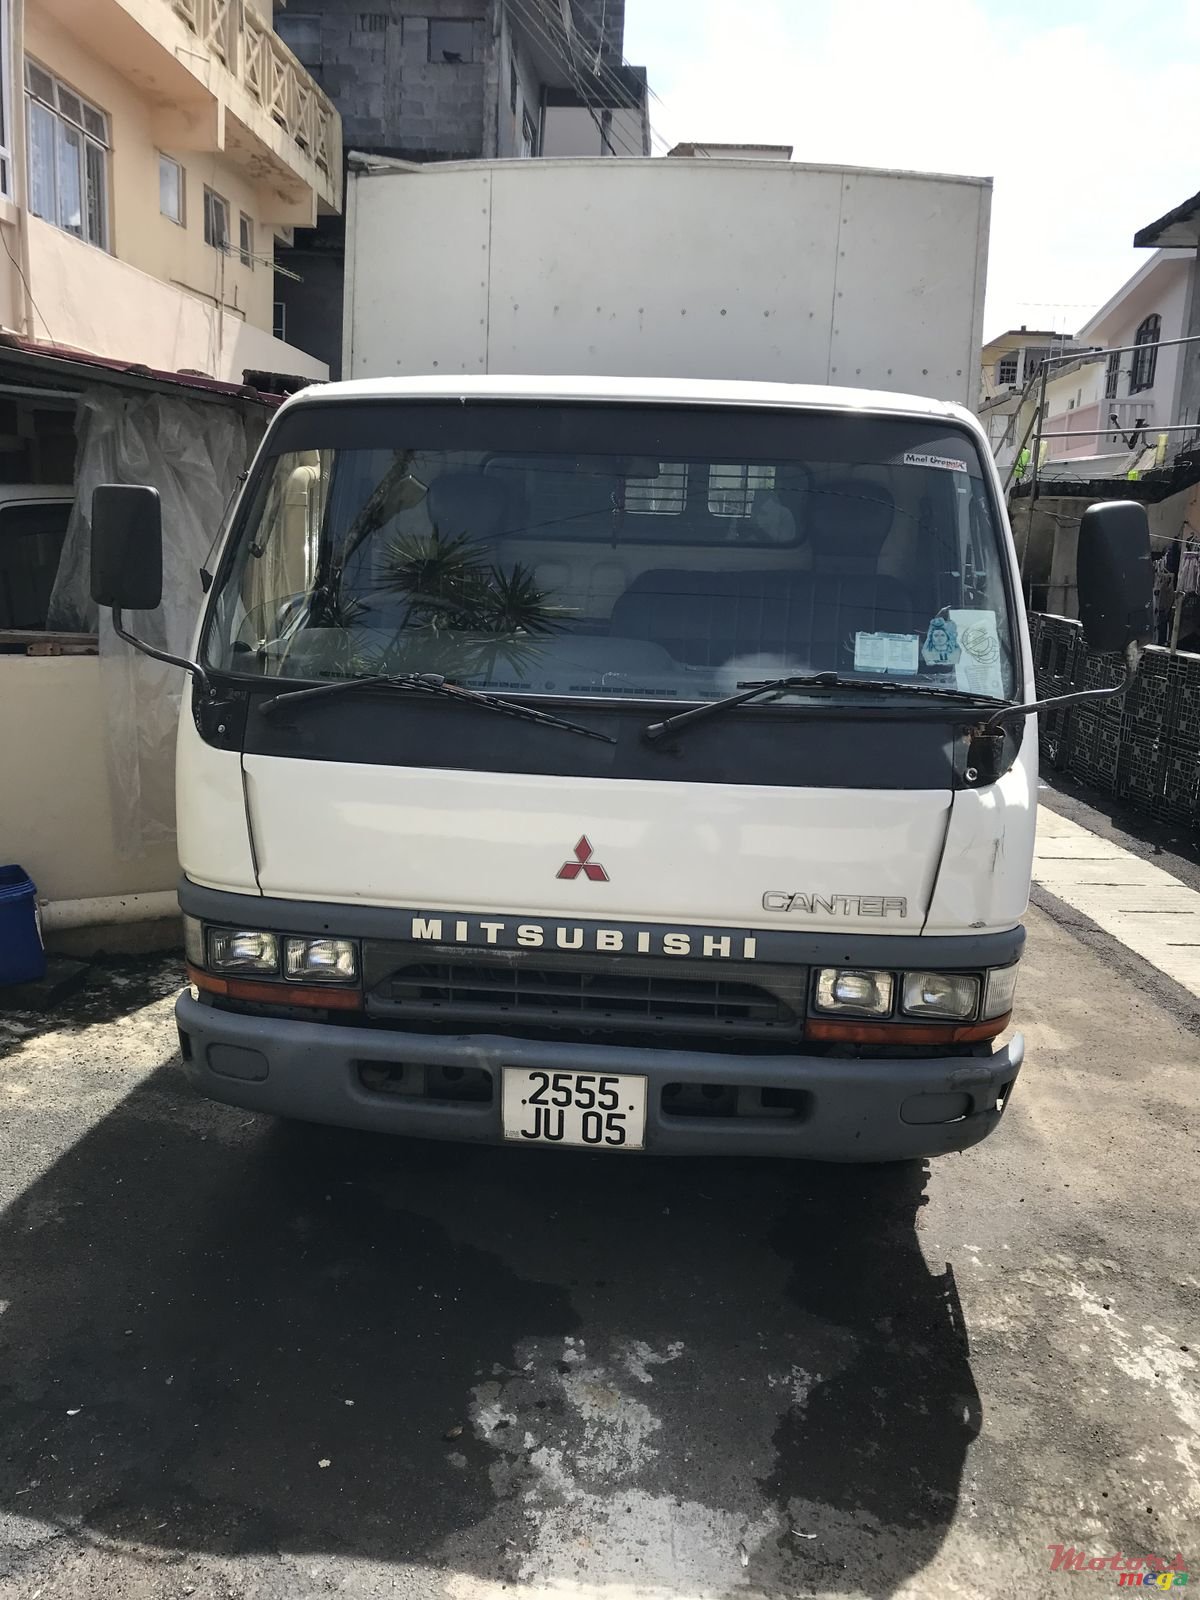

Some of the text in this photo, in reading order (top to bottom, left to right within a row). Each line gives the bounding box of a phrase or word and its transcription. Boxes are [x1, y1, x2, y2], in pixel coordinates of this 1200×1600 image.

[762, 890, 908, 918] CANTER
[411, 918, 757, 959] MITSUBISHI
[528, 1072, 620, 1110] 2555
[520, 1108, 626, 1145] JU 05
